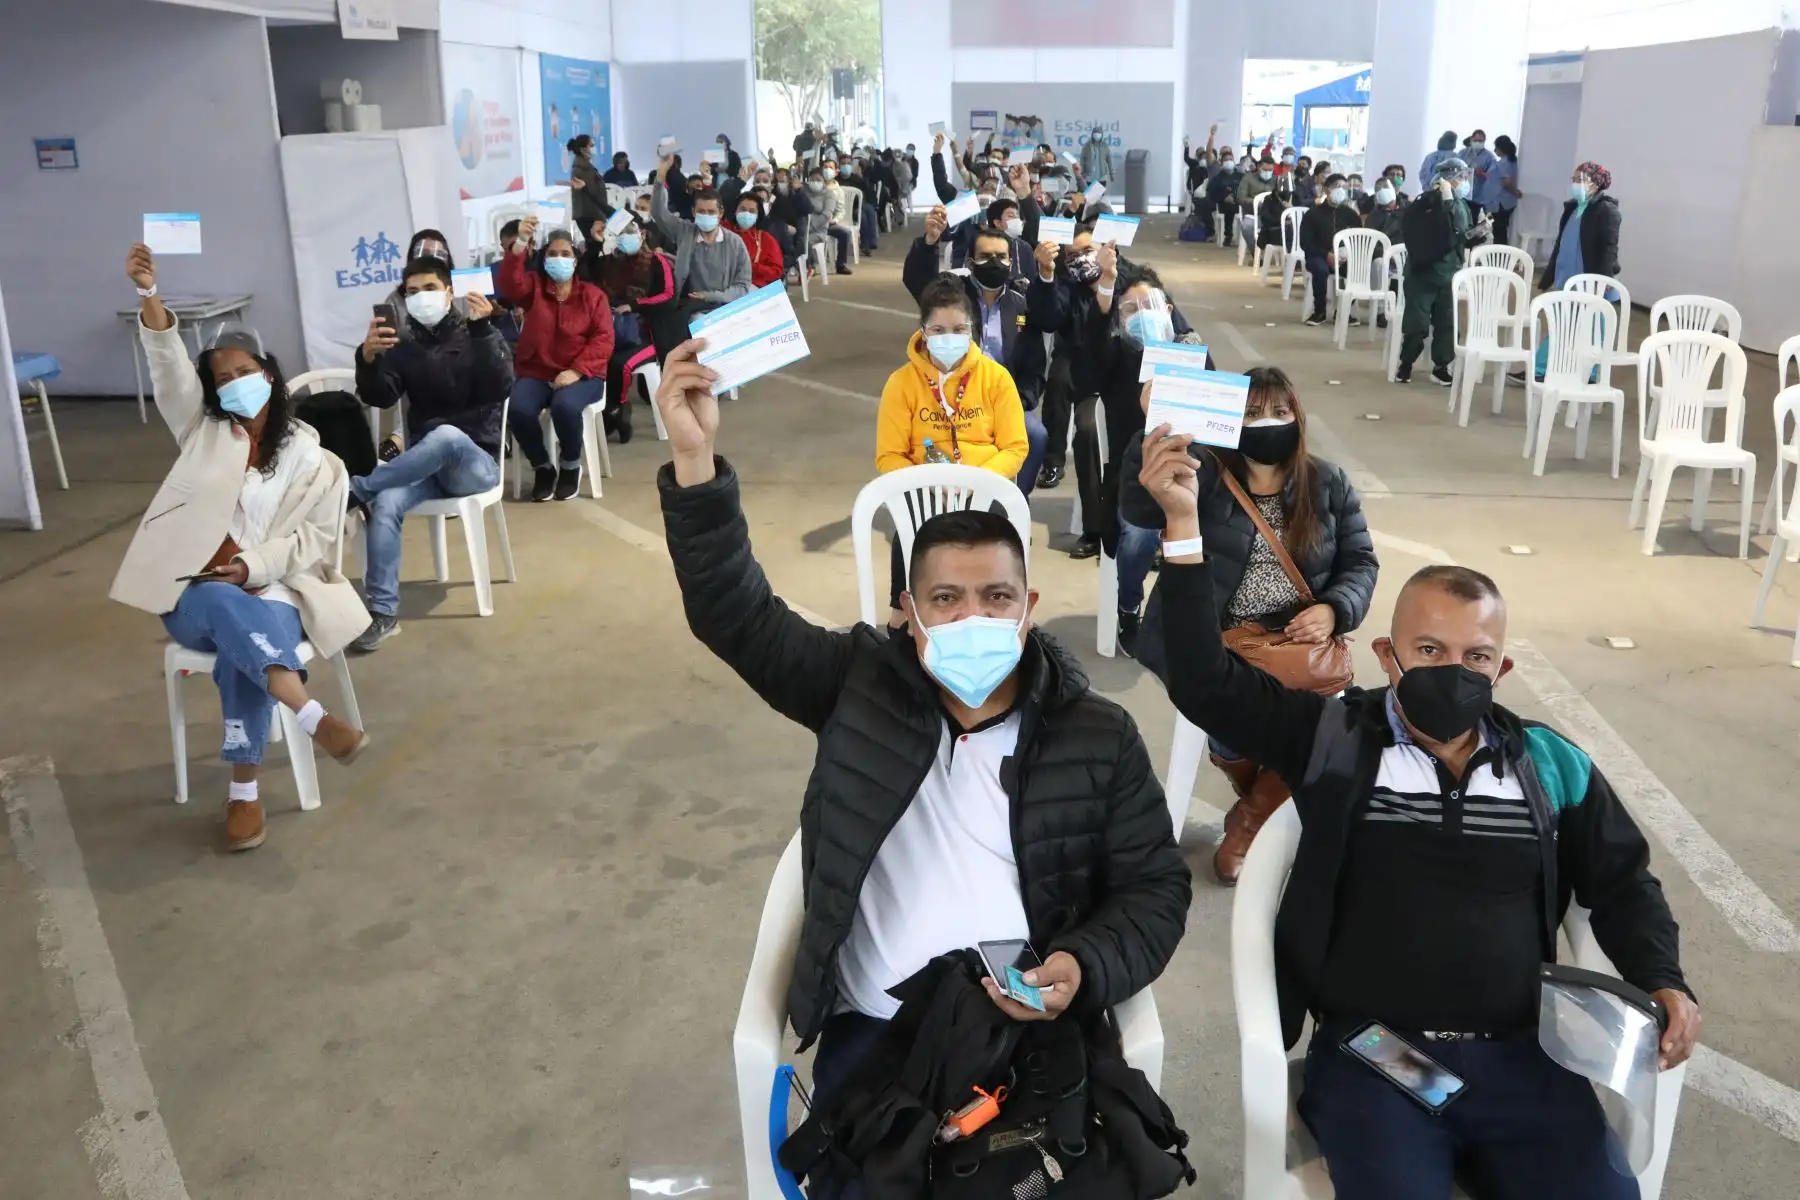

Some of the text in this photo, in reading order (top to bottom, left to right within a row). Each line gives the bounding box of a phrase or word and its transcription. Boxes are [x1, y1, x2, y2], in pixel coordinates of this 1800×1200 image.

[1054, 119, 1120, 132] EsSalud
[1054, 134, 1122, 147] Te Cda
[335, 264, 405, 289] EsSalu
[769, 331, 801, 347] PFIZER
[957, 405, 985, 421] Klein
[932, 422, 972, 431] Perfoance
[1206, 420, 1236, 435] PFIZER
